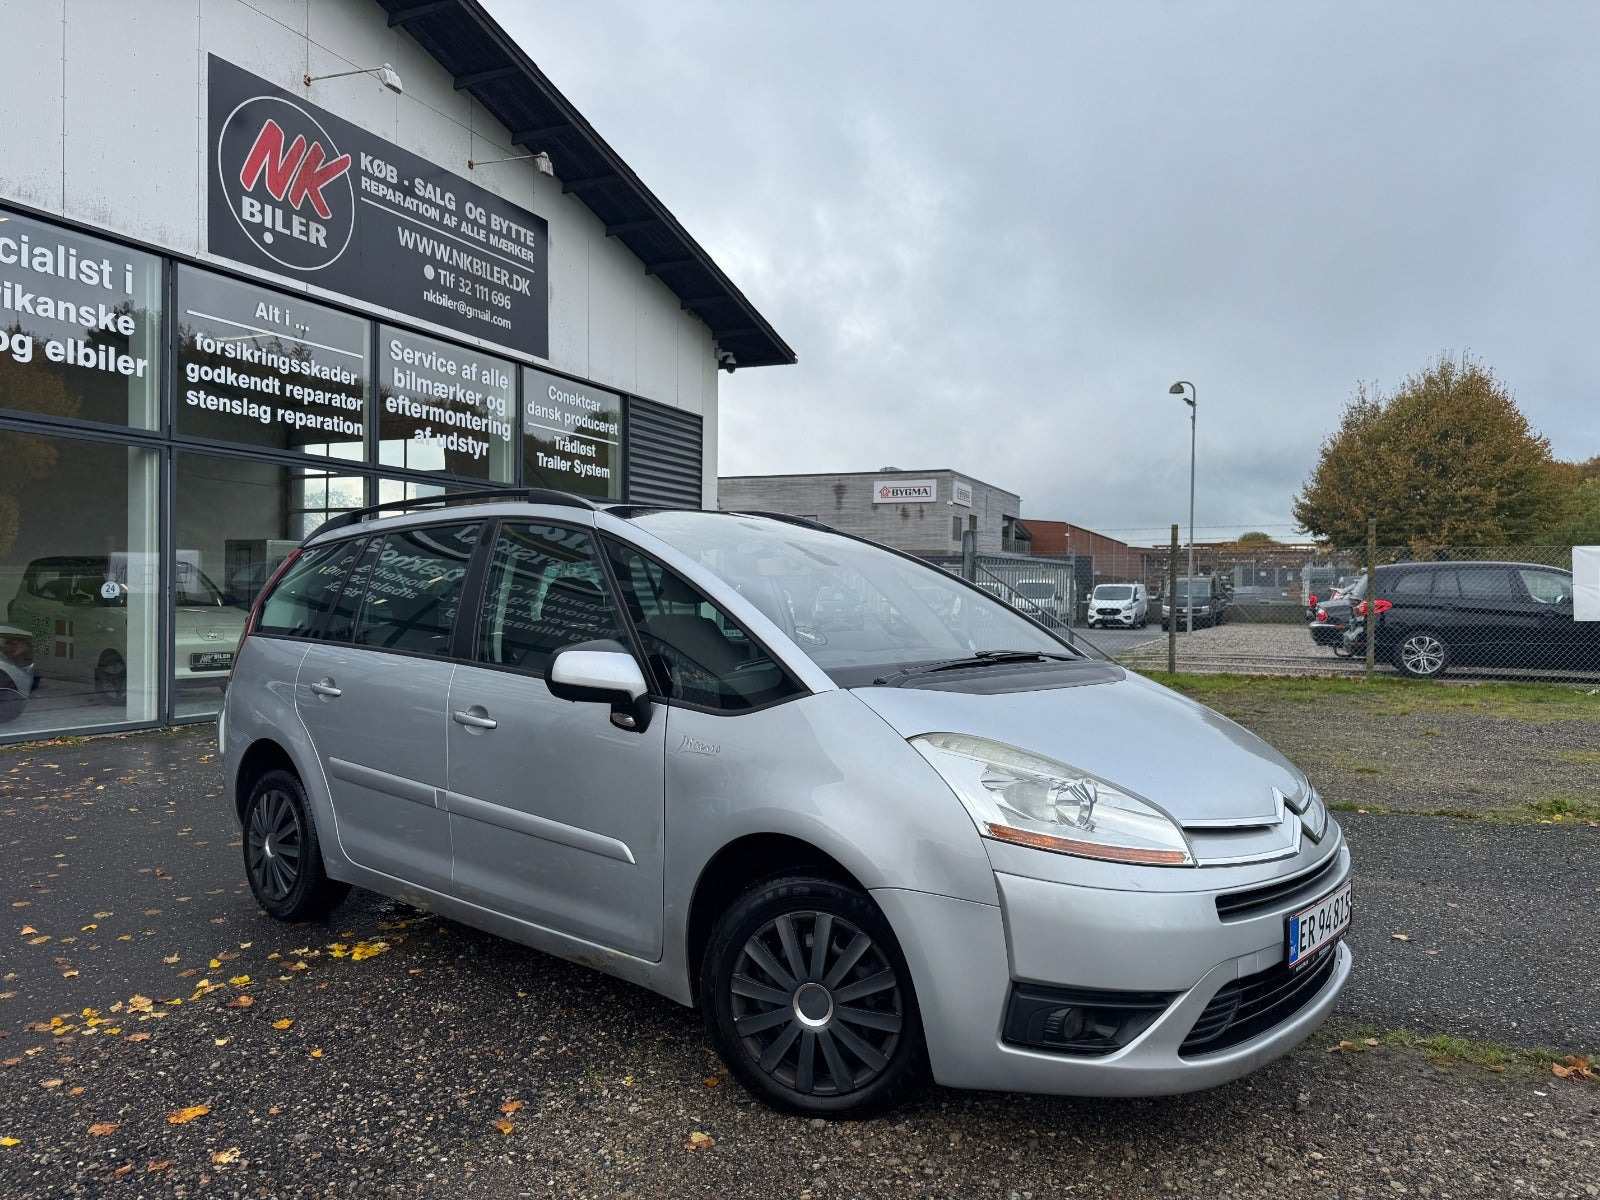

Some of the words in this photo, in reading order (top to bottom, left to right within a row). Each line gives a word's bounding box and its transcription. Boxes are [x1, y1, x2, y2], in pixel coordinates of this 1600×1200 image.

[240, 119, 351, 219] NK
[241, 196, 328, 248] BILER
[361, 152, 398, 184] KØB
[414, 177, 456, 211] SALG
[465, 201, 487, 226] OG
[490, 213, 535, 247] BYTTE
[361, 175, 440, 221] REPARATION
[443, 213, 458, 228] AF
[460, 221, 487, 242] ALLE
[489, 233, 534, 263] MÆRKER
[0, 234, 113, 290] cialist
[125, 264, 133, 295] i
[397, 226, 531, 297] WWW.NKBILER.DK
[0, 280, 136, 336] ikanske
[423, 289, 512, 330] nkbiler@gmail.com
[437, 268, 456, 289] Tlf
[458, 276, 472, 296] 32
[474, 283, 489, 302] 111
[491, 290, 511, 309] 696
[256, 302, 281, 324] Alt
[285, 309, 290, 326] i
[45, 337, 149, 379] elbiler
[195, 332, 358, 386] forsikringsskader
[389, 340, 457, 376] Service
[461, 362, 478, 381] af
[481, 368, 509, 390] alle
[186, 362, 281, 396] godkendt
[285, 383, 364, 412] reparatør
[393, 367, 482, 407] bilmærker
[486, 395, 506, 417] og
[548, 385, 601, 412] Conektcar
[186, 389, 272, 424] stenslag
[277, 408, 364, 436] reparation
[385, 396, 512, 442] eftermontering
[527, 400, 561, 422] dansk
[564, 411, 619, 436] produceret
[414, 426, 432, 446] af
[436, 432, 489, 460] udstyr
[536, 451, 572, 472] Trailer
[574, 460, 611, 479] System
[553, 435, 597, 458] Trådløst
[892, 488, 928, 496] BYGMA
[106, 584, 116, 593] 24
[1300, 914, 1316, 953] ER
[1319, 903, 1332, 941] 94
[1333, 889, 1351, 930] 815
